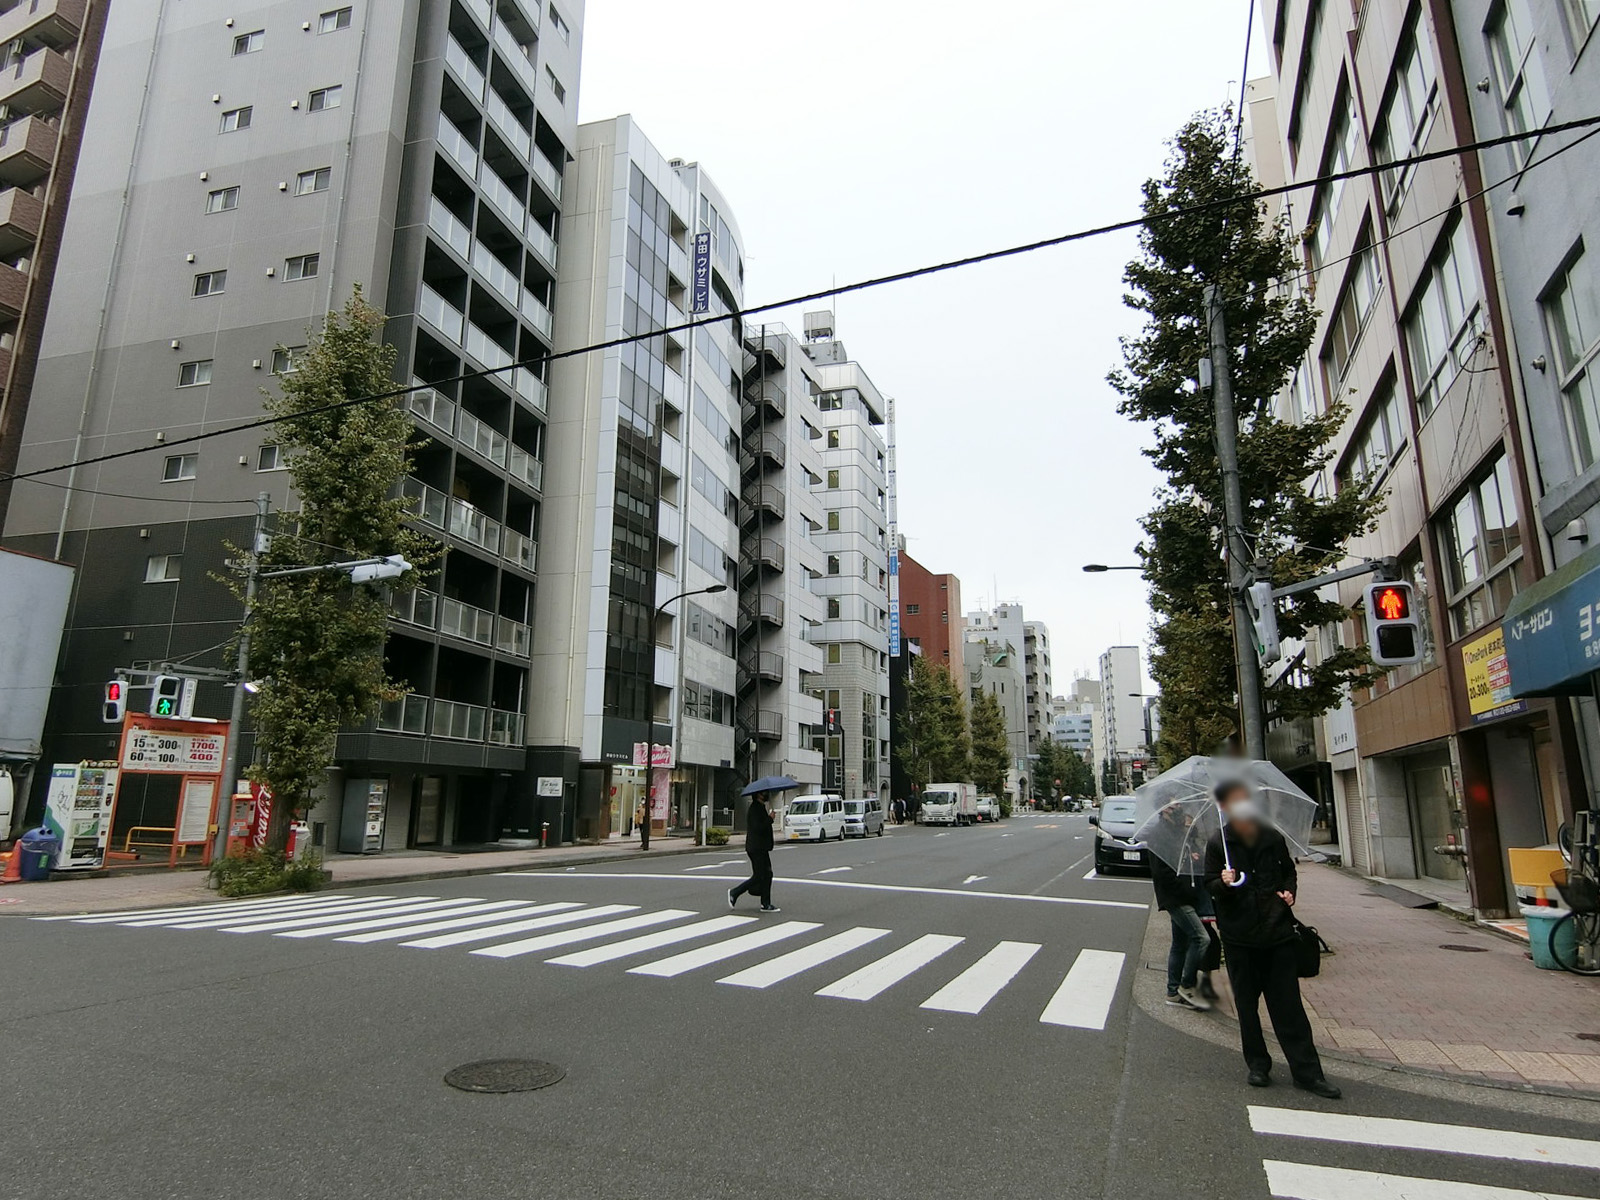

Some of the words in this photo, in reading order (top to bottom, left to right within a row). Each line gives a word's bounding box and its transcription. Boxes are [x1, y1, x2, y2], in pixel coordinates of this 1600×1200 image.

[1511, 607, 1553, 641] ヘアーサロン
[1579, 603, 1600, 641] ヨ
